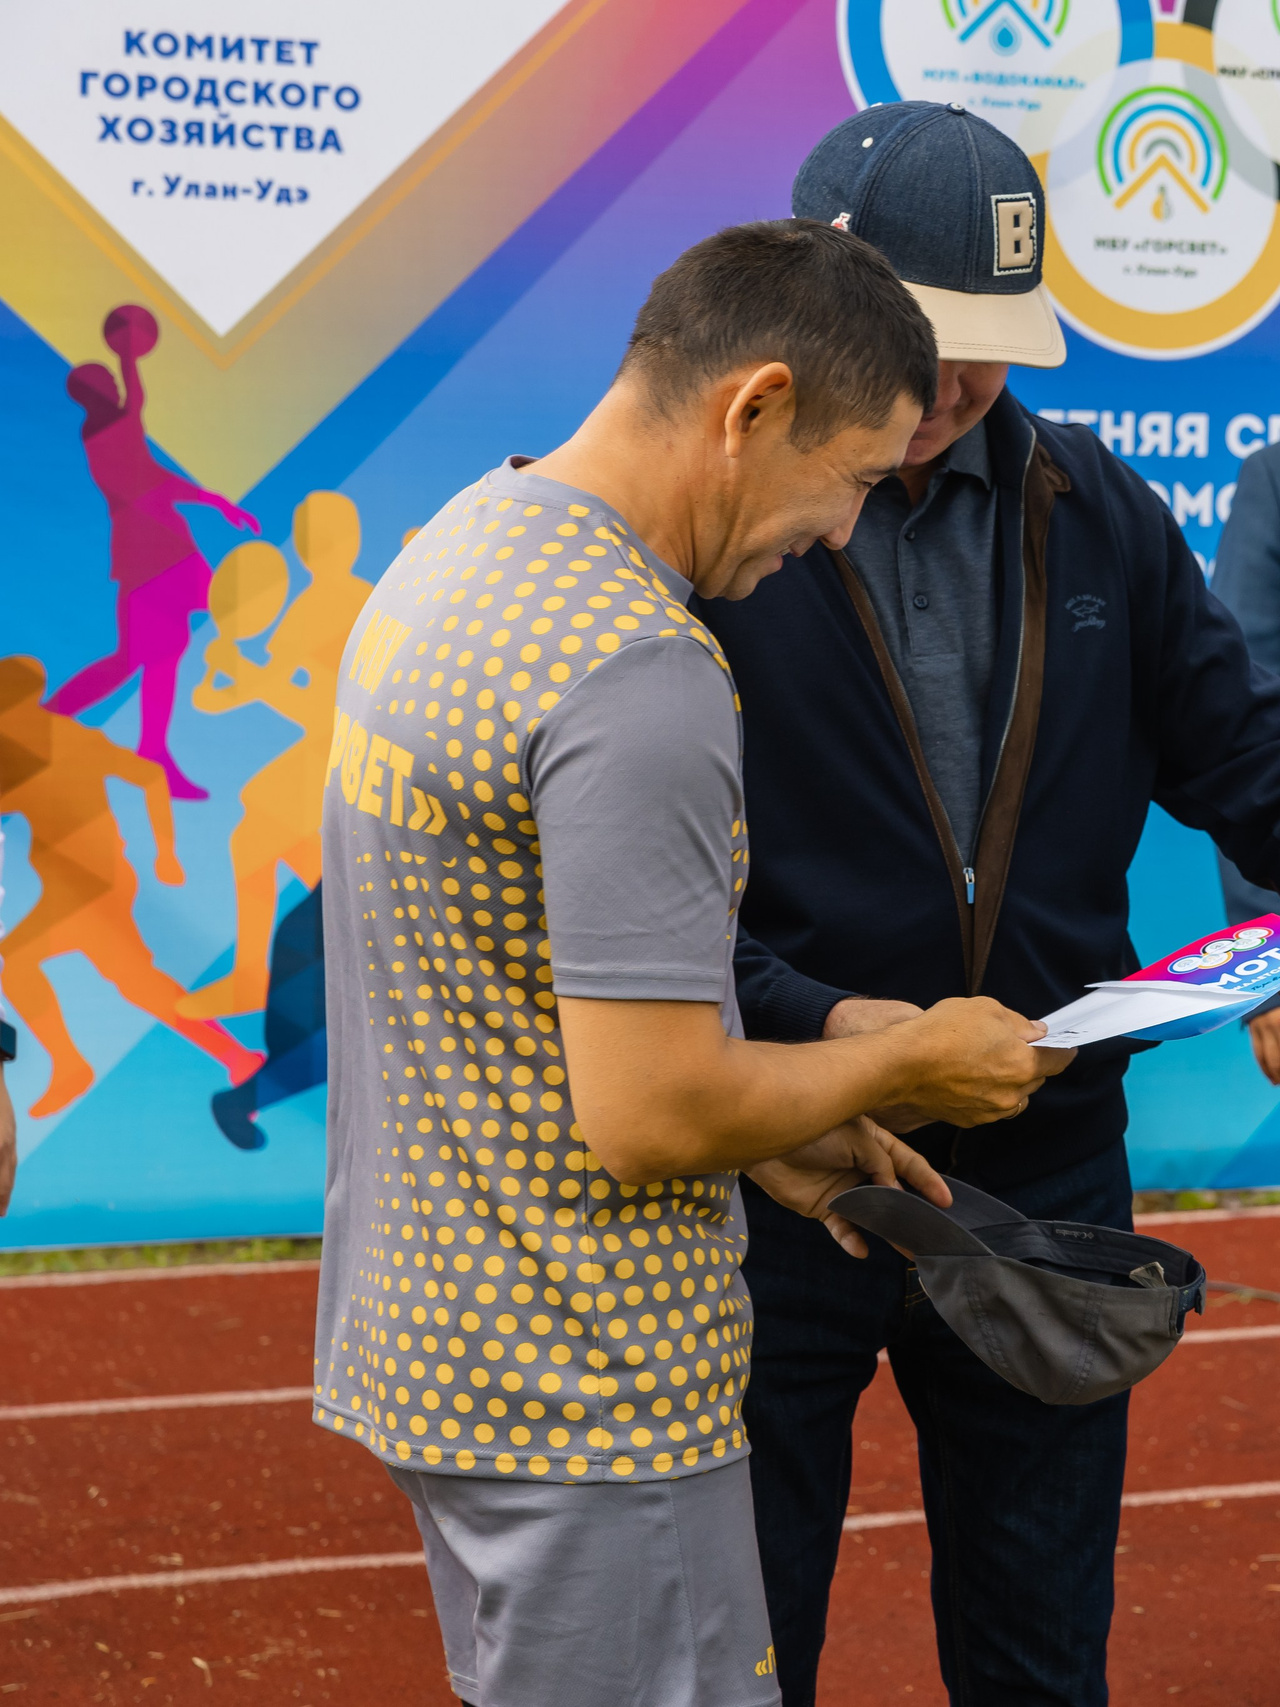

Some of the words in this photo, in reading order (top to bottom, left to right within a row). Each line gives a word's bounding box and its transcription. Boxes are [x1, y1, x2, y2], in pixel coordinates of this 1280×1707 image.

[124, 30, 319, 66] КОМИТЕТ
[79, 71, 361, 112] ГОРОДСКОГО
[98, 112, 343, 153] ХОЗЯЙСТВА
[131, 178, 154, 196] г.
[164, 175, 309, 205] Улан-Удэ
[349, 609, 413, 695] МБУ
[325, 706, 449, 836] РСВЕТ»
